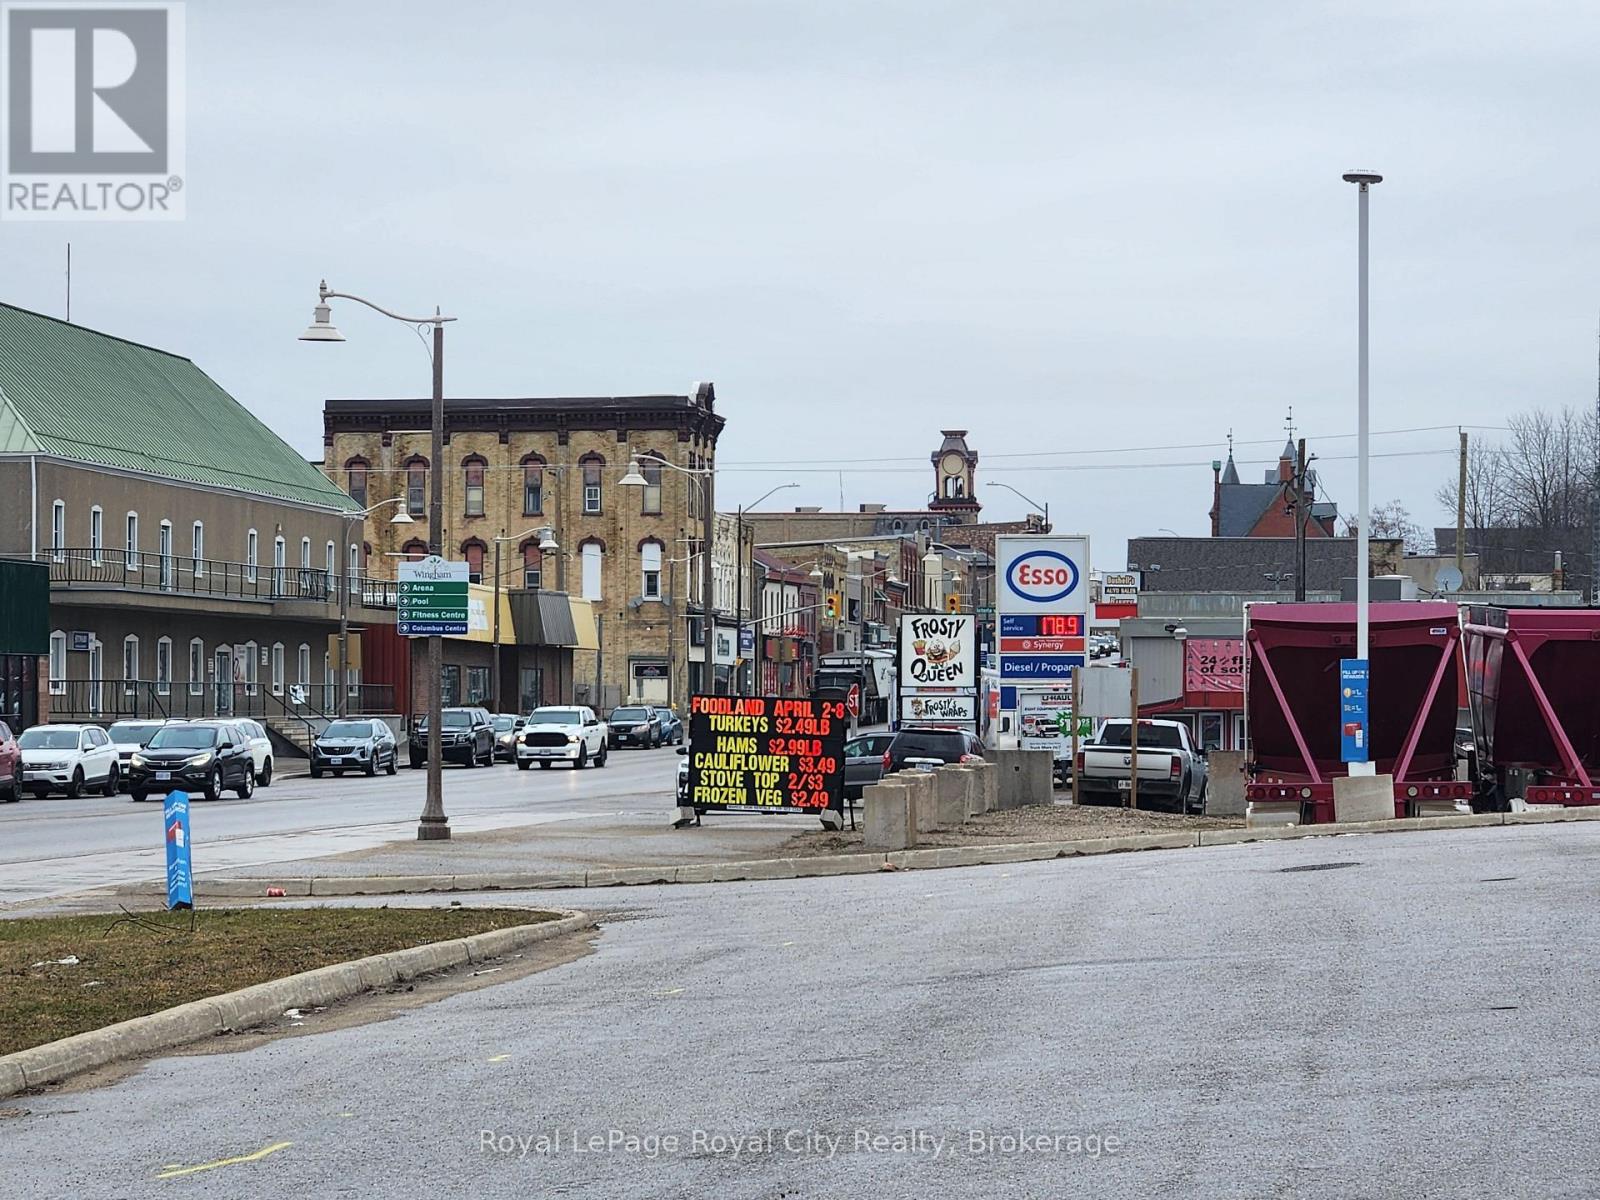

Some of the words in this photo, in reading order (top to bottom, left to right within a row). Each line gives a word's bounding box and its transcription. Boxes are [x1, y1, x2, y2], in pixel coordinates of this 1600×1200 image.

[413, 570, 452, 580] Wingham
[1018, 564, 1069, 585] Esso
[412, 611, 439, 619] Fitness
[911, 618, 966, 639] FROSTY
[1034, 641, 1064, 650] Synergy
[1004, 662, 1033, 672] Diesel
[1200, 655, 1217, 665] 24
[910, 658, 963, 683] QUEEN
[692, 697, 765, 716] FOODLAND
[774, 700, 815, 717] APRIL
[822, 702, 845, 718] 2-8
[940, 707, 968, 718] WRAPS
[709, 715, 769, 732] TURKEYS
[776, 718, 831, 735] $2.49LB
[716, 736, 758, 753] HAMS
[768, 738, 823, 756] $2.99LB
[694, 753, 789, 772] CAULIFLOWER
[798, 757, 836, 774] $3.49
[700, 769, 744, 788] STOVE
[753, 772, 780, 788] TOP
[788, 772, 824, 790] 2/$3
[693, 787, 747, 805] FROZEN
[756, 789, 782, 806] VEG
[791, 791, 829, 807] $2.49
